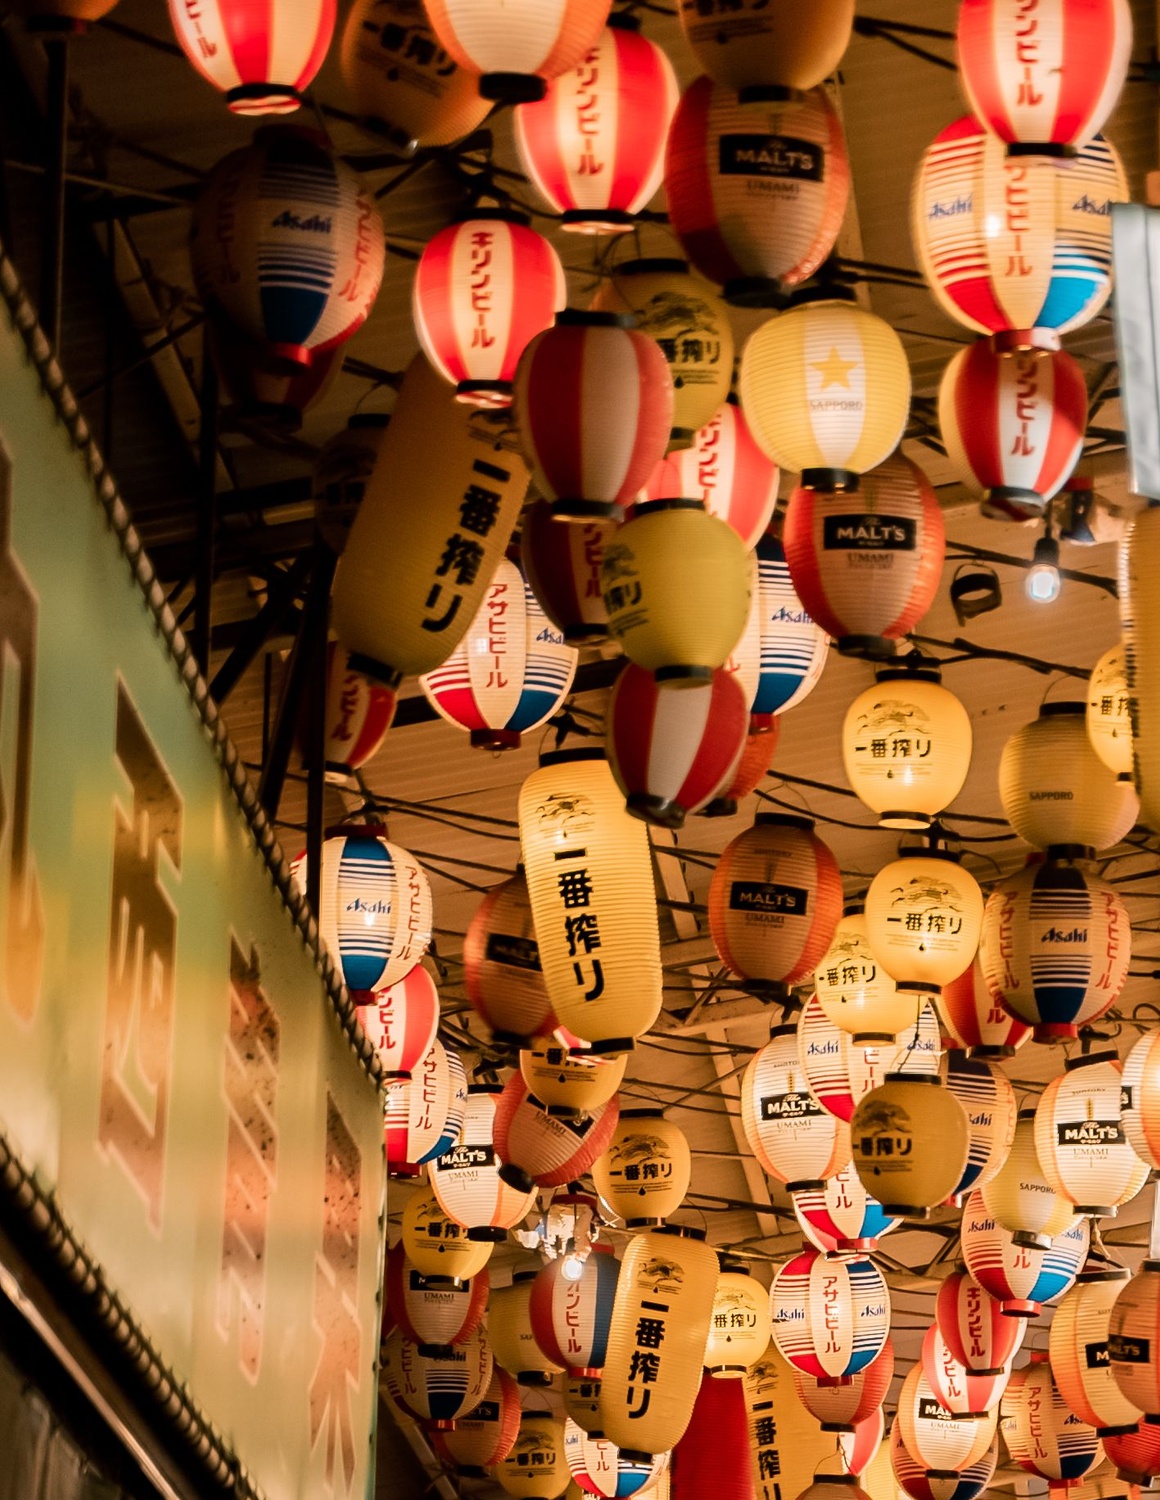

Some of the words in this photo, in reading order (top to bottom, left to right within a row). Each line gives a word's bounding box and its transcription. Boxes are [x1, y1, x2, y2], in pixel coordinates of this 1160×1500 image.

[734, 149, 813, 170] MALT'S
[471, 231, 496, 350] キリンビール
[1010, 358, 1036, 457] リンビール
[837, 525, 905, 542] MALT'S
[421, 459, 511, 633] 一番搾り
[847, 552, 893, 564] UMAMI
[486, 582, 509, 689] アサヒビール
[855, 738, 931, 759] 一番搾り
[1029, 791, 1073, 801] SAPPORO
[347, 898, 392, 915] Asahi
[739, 891, 796, 906] MALT'S
[397, 865, 422, 961] アサヒビール
[746, 914, 785, 924] UMAMI
[554, 848, 604, 1001] 一番搾り
[887, 914, 962, 936] 一番搾り
[1000, 890, 1020, 991] アサヒビール
[1041, 926, 1088, 944] Asahi
[1096, 890, 1121, 991] アサヒビール
[818, 965, 876, 987] 一番搾り
[807, 1040, 840, 1056] Asahi
[767, 1098, 819, 1114] MALT'S
[776, 1120, 812, 1130] UMAMI
[1065, 1127, 1119, 1142] MALT'S
[441, 1150, 487, 1165] MALT'S
[448, 1171, 479, 1181] UMAMI
[968, 1219, 996, 1233] Asahi
[776, 1308, 805, 1321] Asahi
[822, 1276, 841, 1354] アサヒビール
[861, 1304, 886, 1318] Asahi
[626, 1300, 670, 1419] 一番搾り
[1027, 1386, 1048, 1460] アサヒビール
[505, 1453, 556, 1466] 一番搾り
